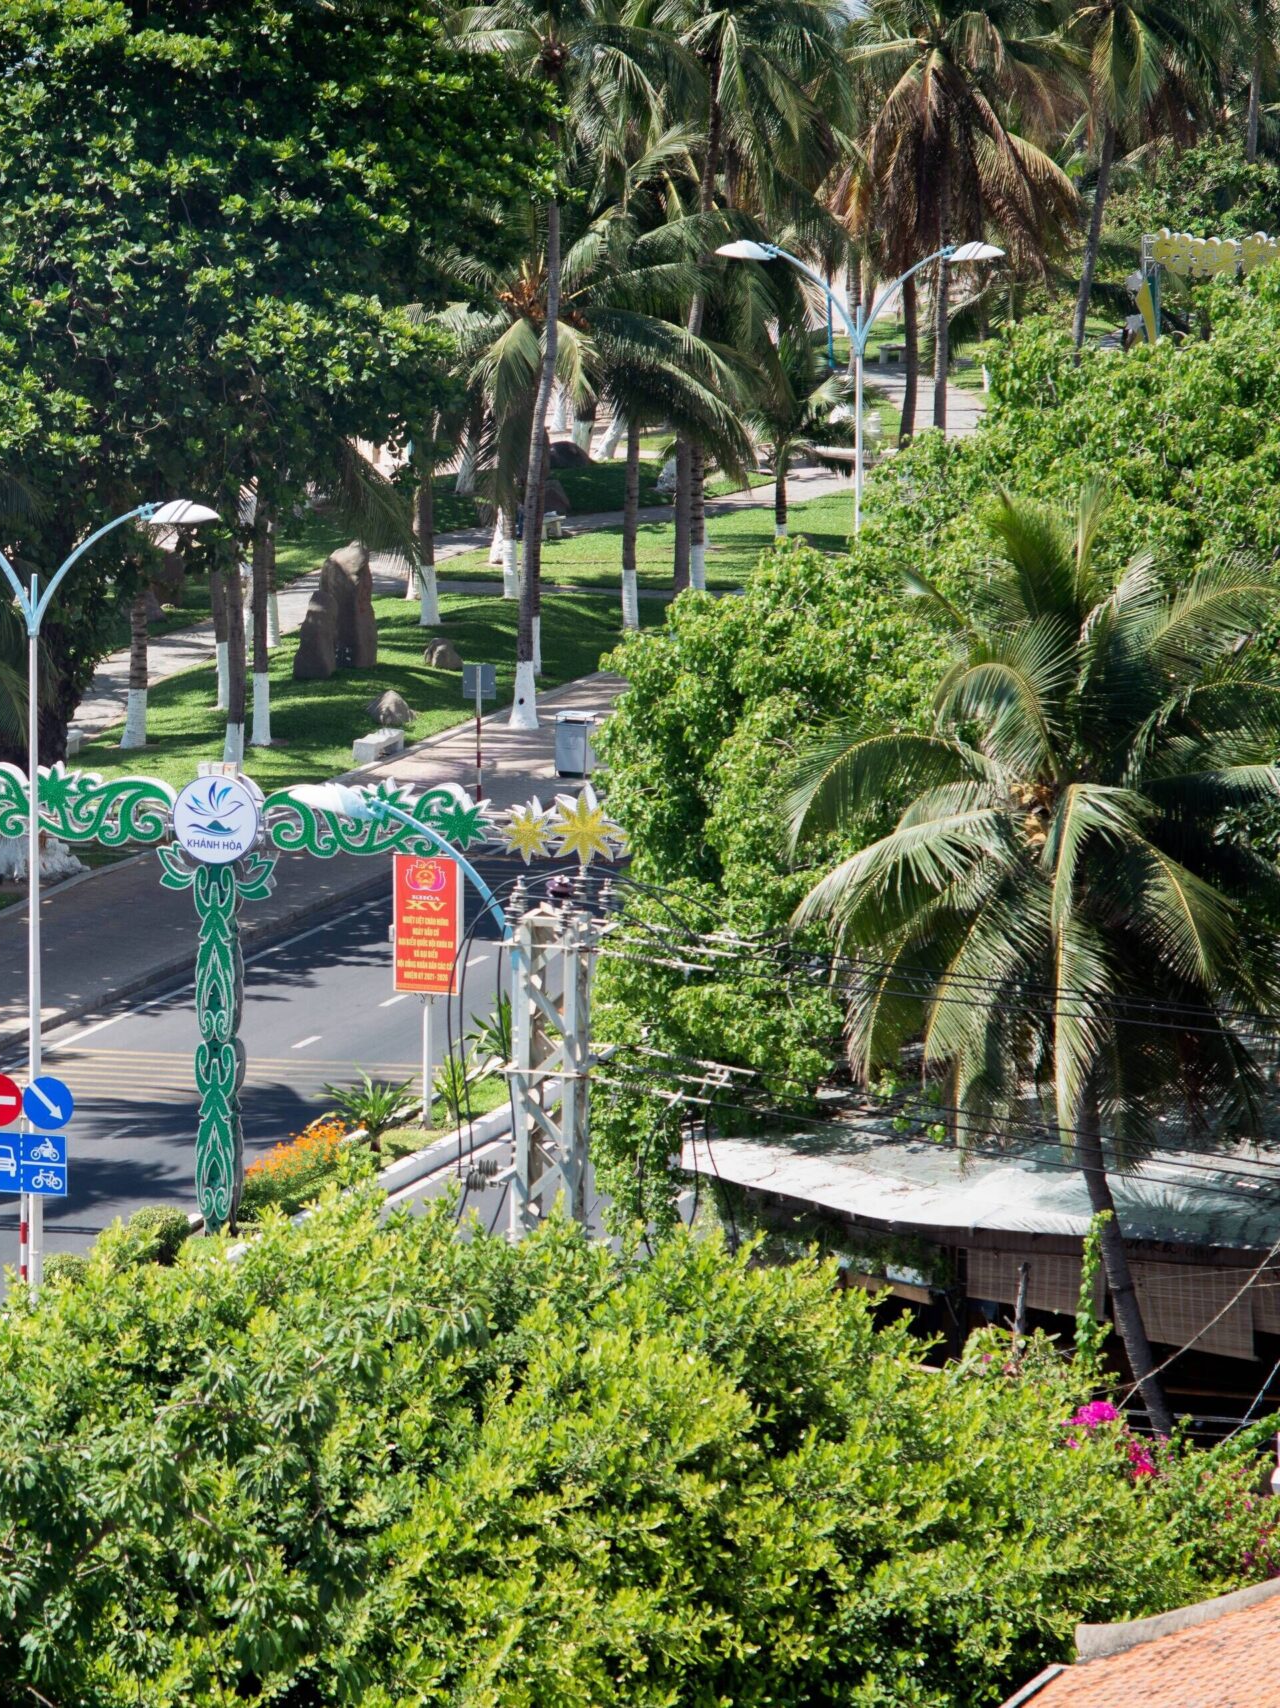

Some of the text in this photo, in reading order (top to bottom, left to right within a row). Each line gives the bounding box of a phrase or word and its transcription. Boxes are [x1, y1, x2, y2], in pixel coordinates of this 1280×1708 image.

[187, 837, 242, 851] KHÁNH HÒA
[405, 900, 447, 911] XV
